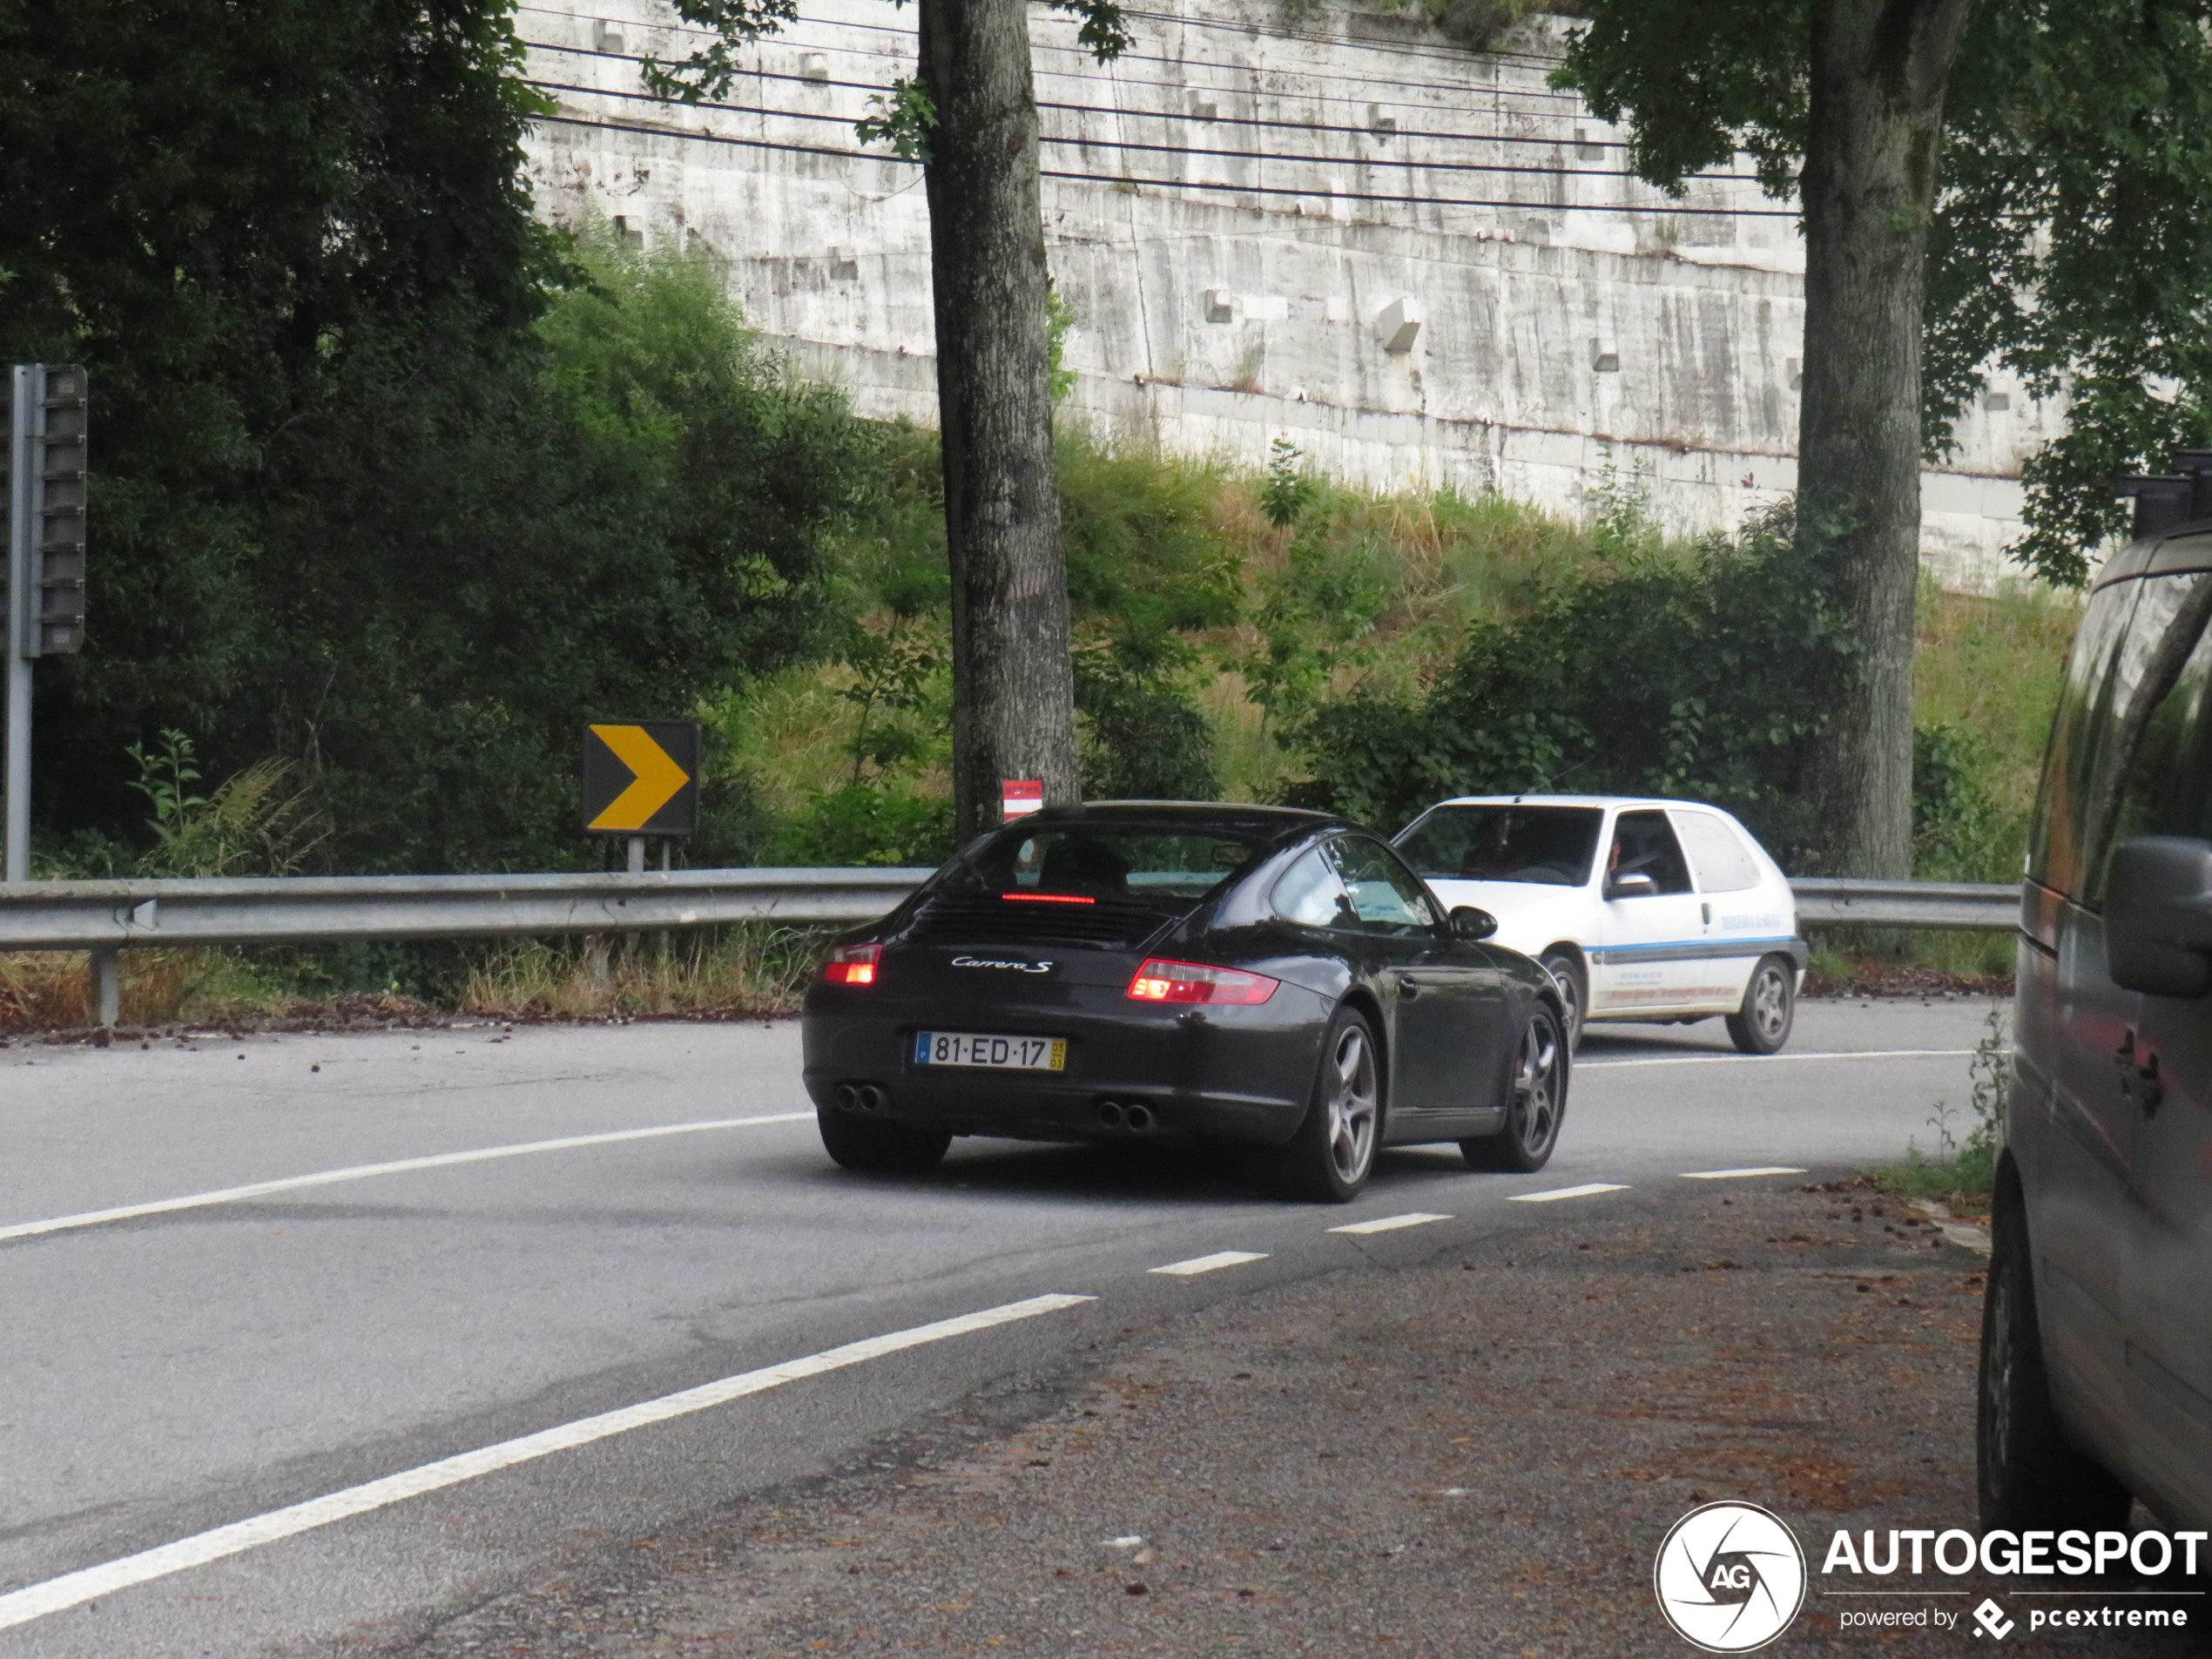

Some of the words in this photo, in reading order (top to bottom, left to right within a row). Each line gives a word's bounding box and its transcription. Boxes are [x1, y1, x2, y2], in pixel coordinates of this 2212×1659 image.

[951, 956, 1028, 969] Carrera
[1024, 961, 1053, 973] S
[1053, 1042, 1064, 1052] 05
[1050, 1059, 1062, 1069] 03
